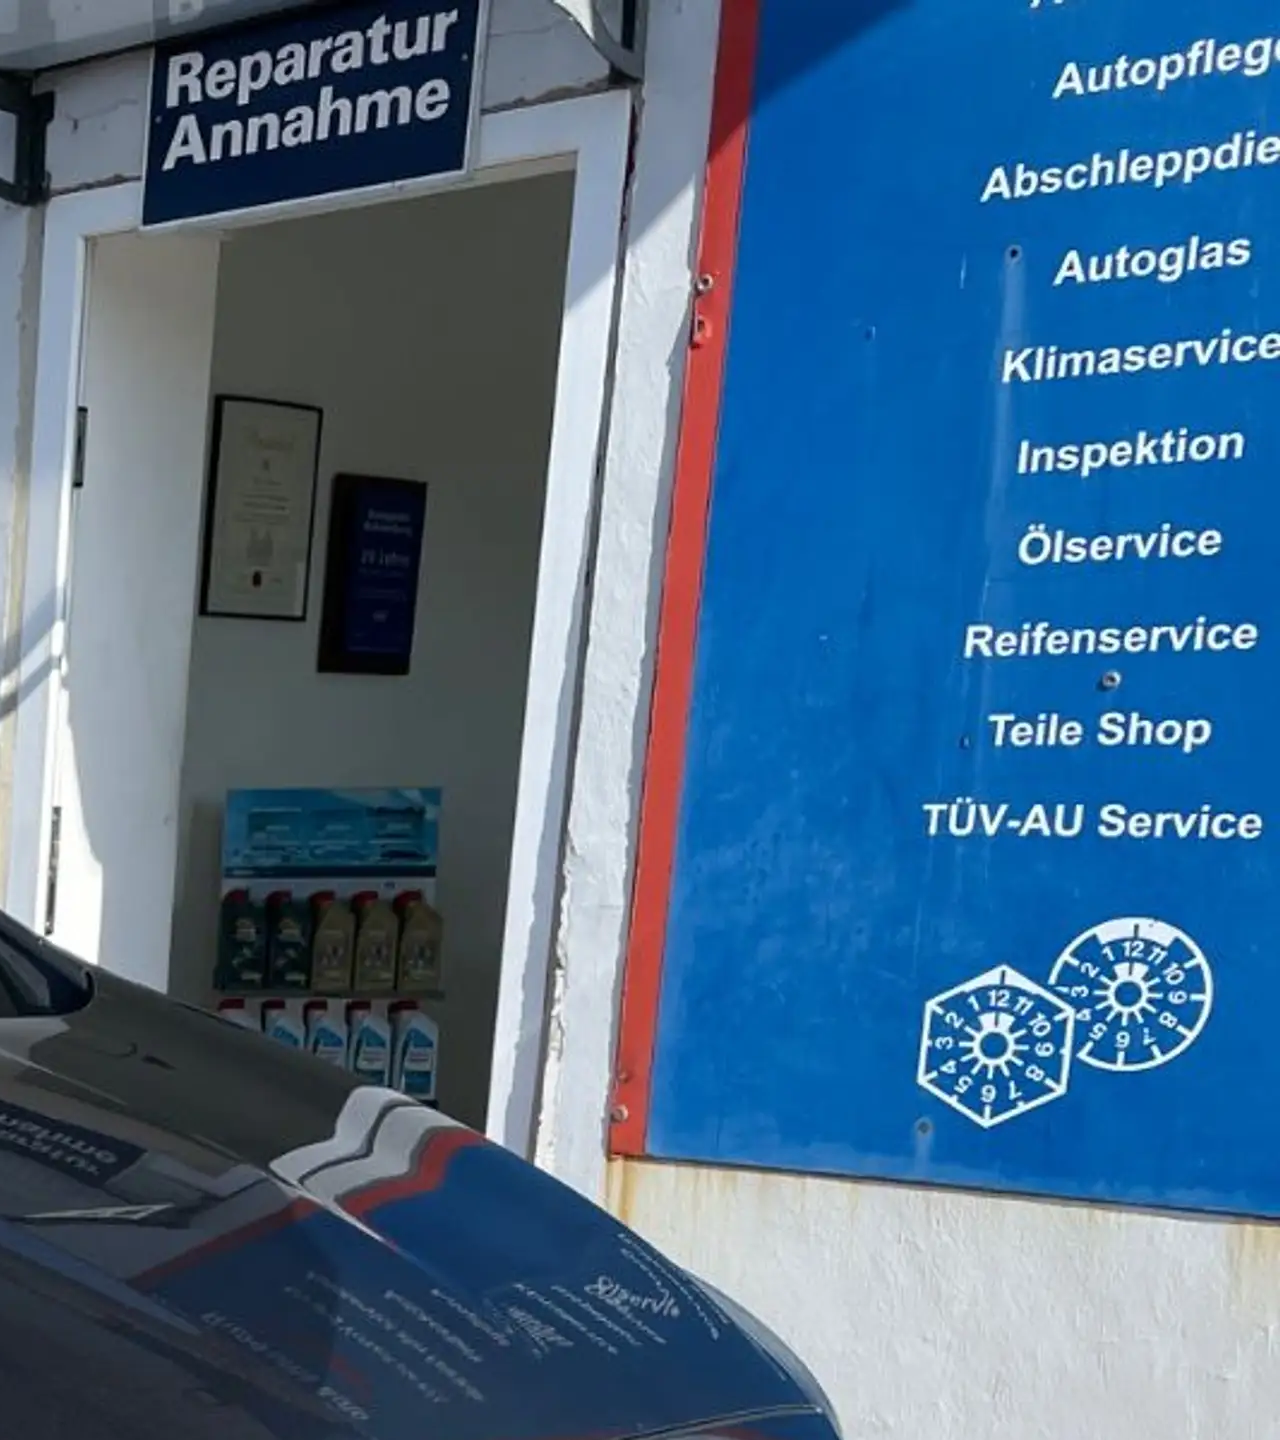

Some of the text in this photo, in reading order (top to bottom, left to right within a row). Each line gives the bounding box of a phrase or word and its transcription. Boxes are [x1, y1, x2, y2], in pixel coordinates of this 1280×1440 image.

[166, 8, 459, 107] Reparatur
[1052, 36, 1280, 99] Autopfleg
[161, 77, 449, 172] Annahme
[1053, 235, 1252, 286] Autoglas
[1002, 329, 1280, 383] Klimaservice
[1017, 427, 1245, 478] Inspektion
[1018, 523, 1223, 565] Ölservice
[964, 616, 1259, 659] Reifenservice
[988, 712, 1212, 754] Teile Shop
[923, 797, 1263, 840] TÜV-AU Service
